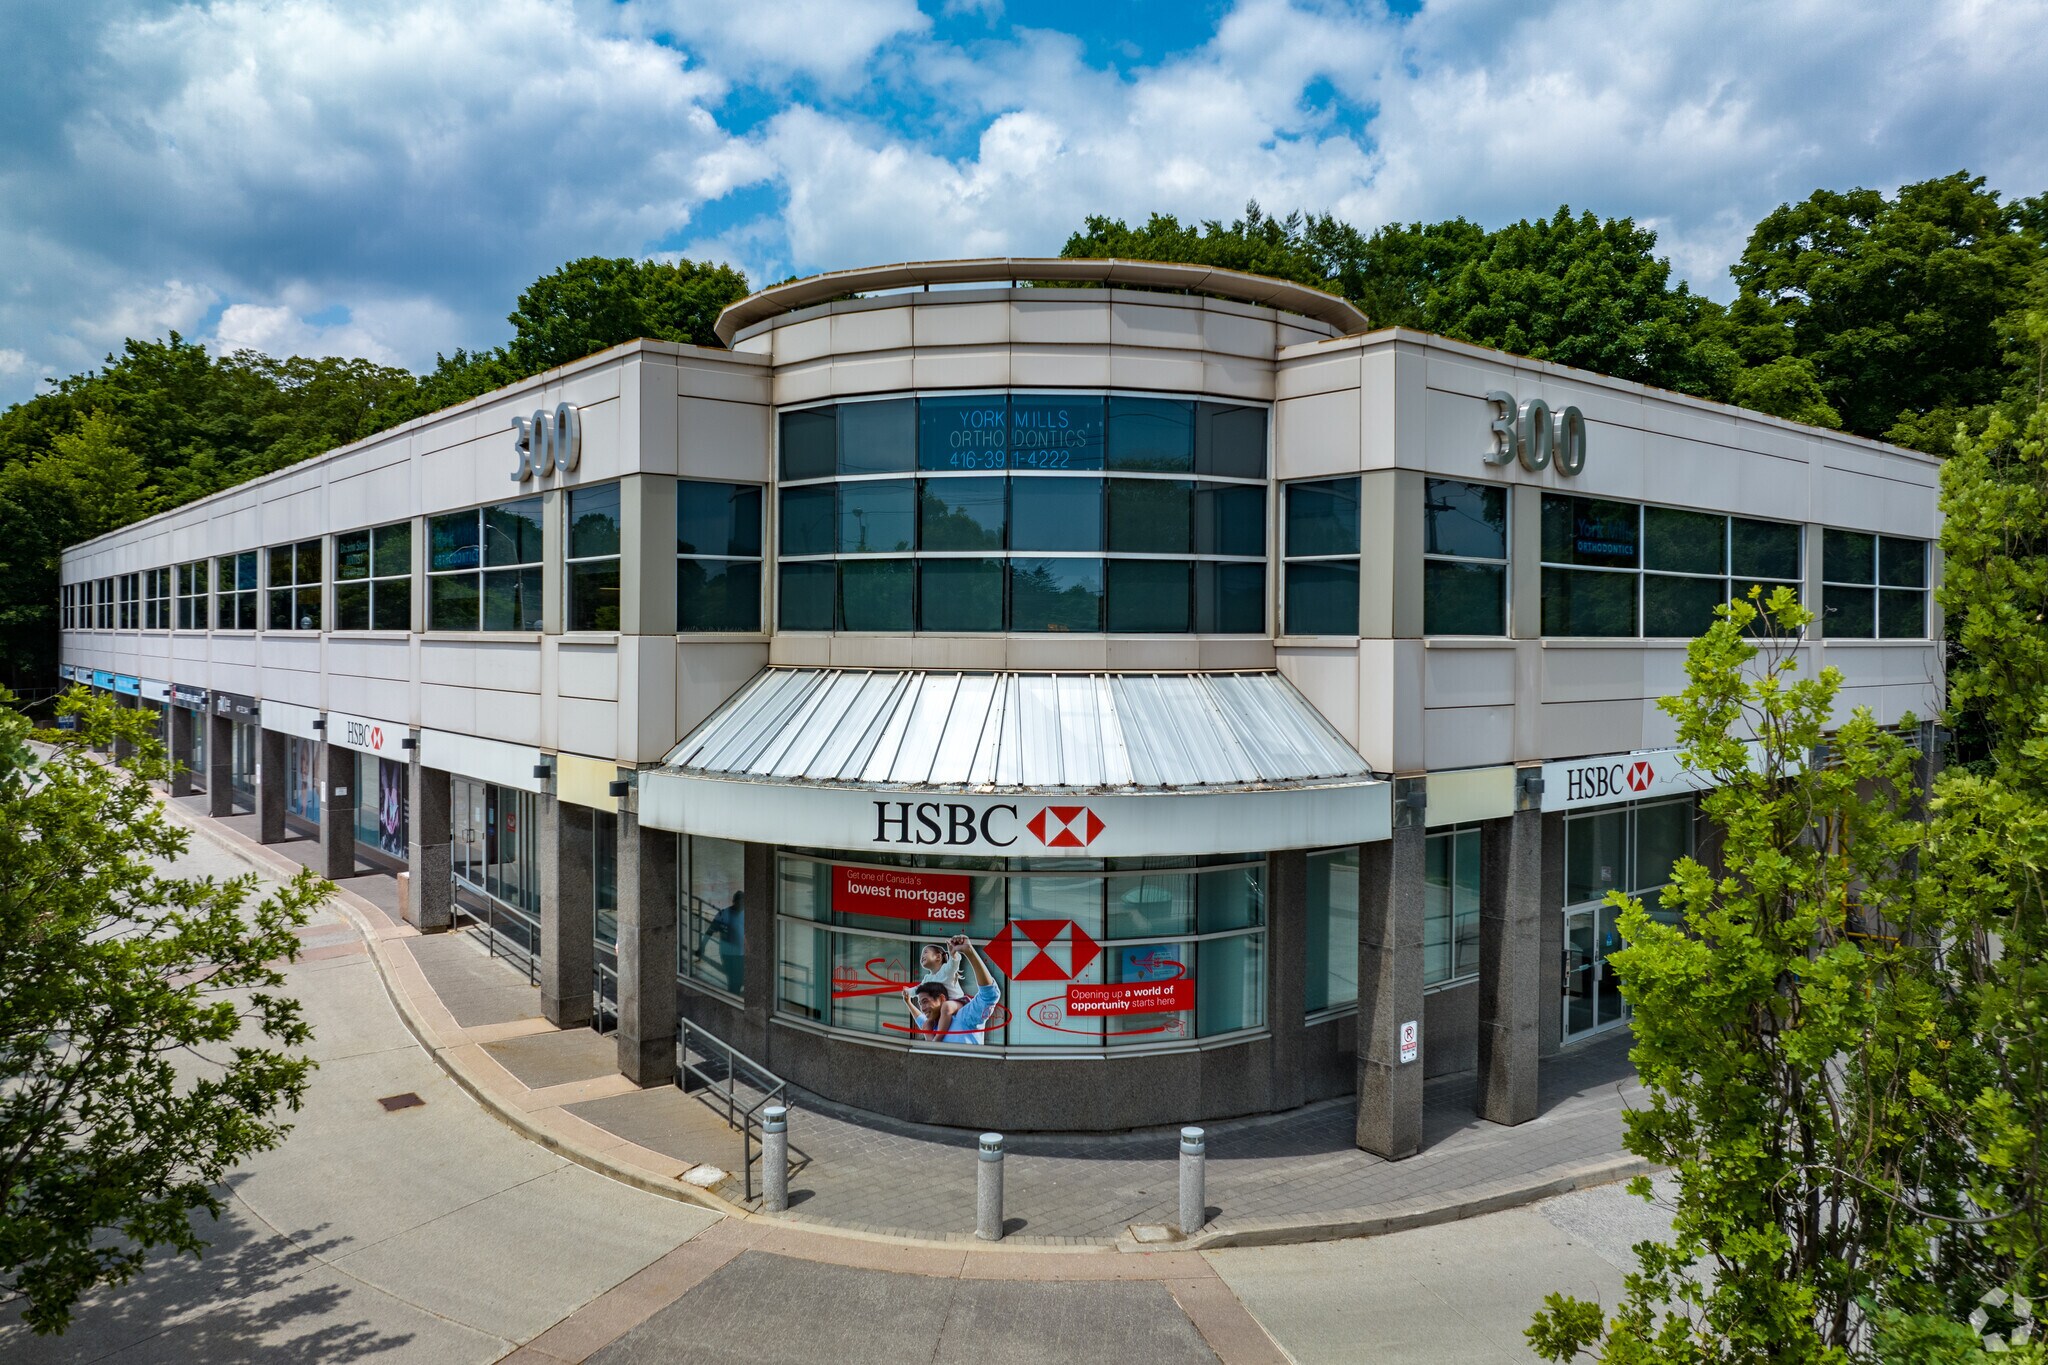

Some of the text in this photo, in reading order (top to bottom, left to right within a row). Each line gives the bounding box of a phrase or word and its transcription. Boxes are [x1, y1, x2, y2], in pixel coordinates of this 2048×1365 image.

[959, 410, 1069, 428] YORK MILLS
[510, 402, 581, 482] 300
[1483, 390, 1586, 477] 300
[1577, 541, 1633, 555] ORTHODONTICS
[347, 721, 371, 748] HSBC
[1566, 763, 1625, 801] HSBC
[872, 801, 1018, 847] HSBC
[847, 869, 922, 886] Get one of Canada's
[848, 880, 966, 905] lowest mortgage
[927, 906, 966, 920] rates
[1071, 984, 1175, 1001] Opening up a world of
[1071, 996, 1176, 1012] opportunity starts here
